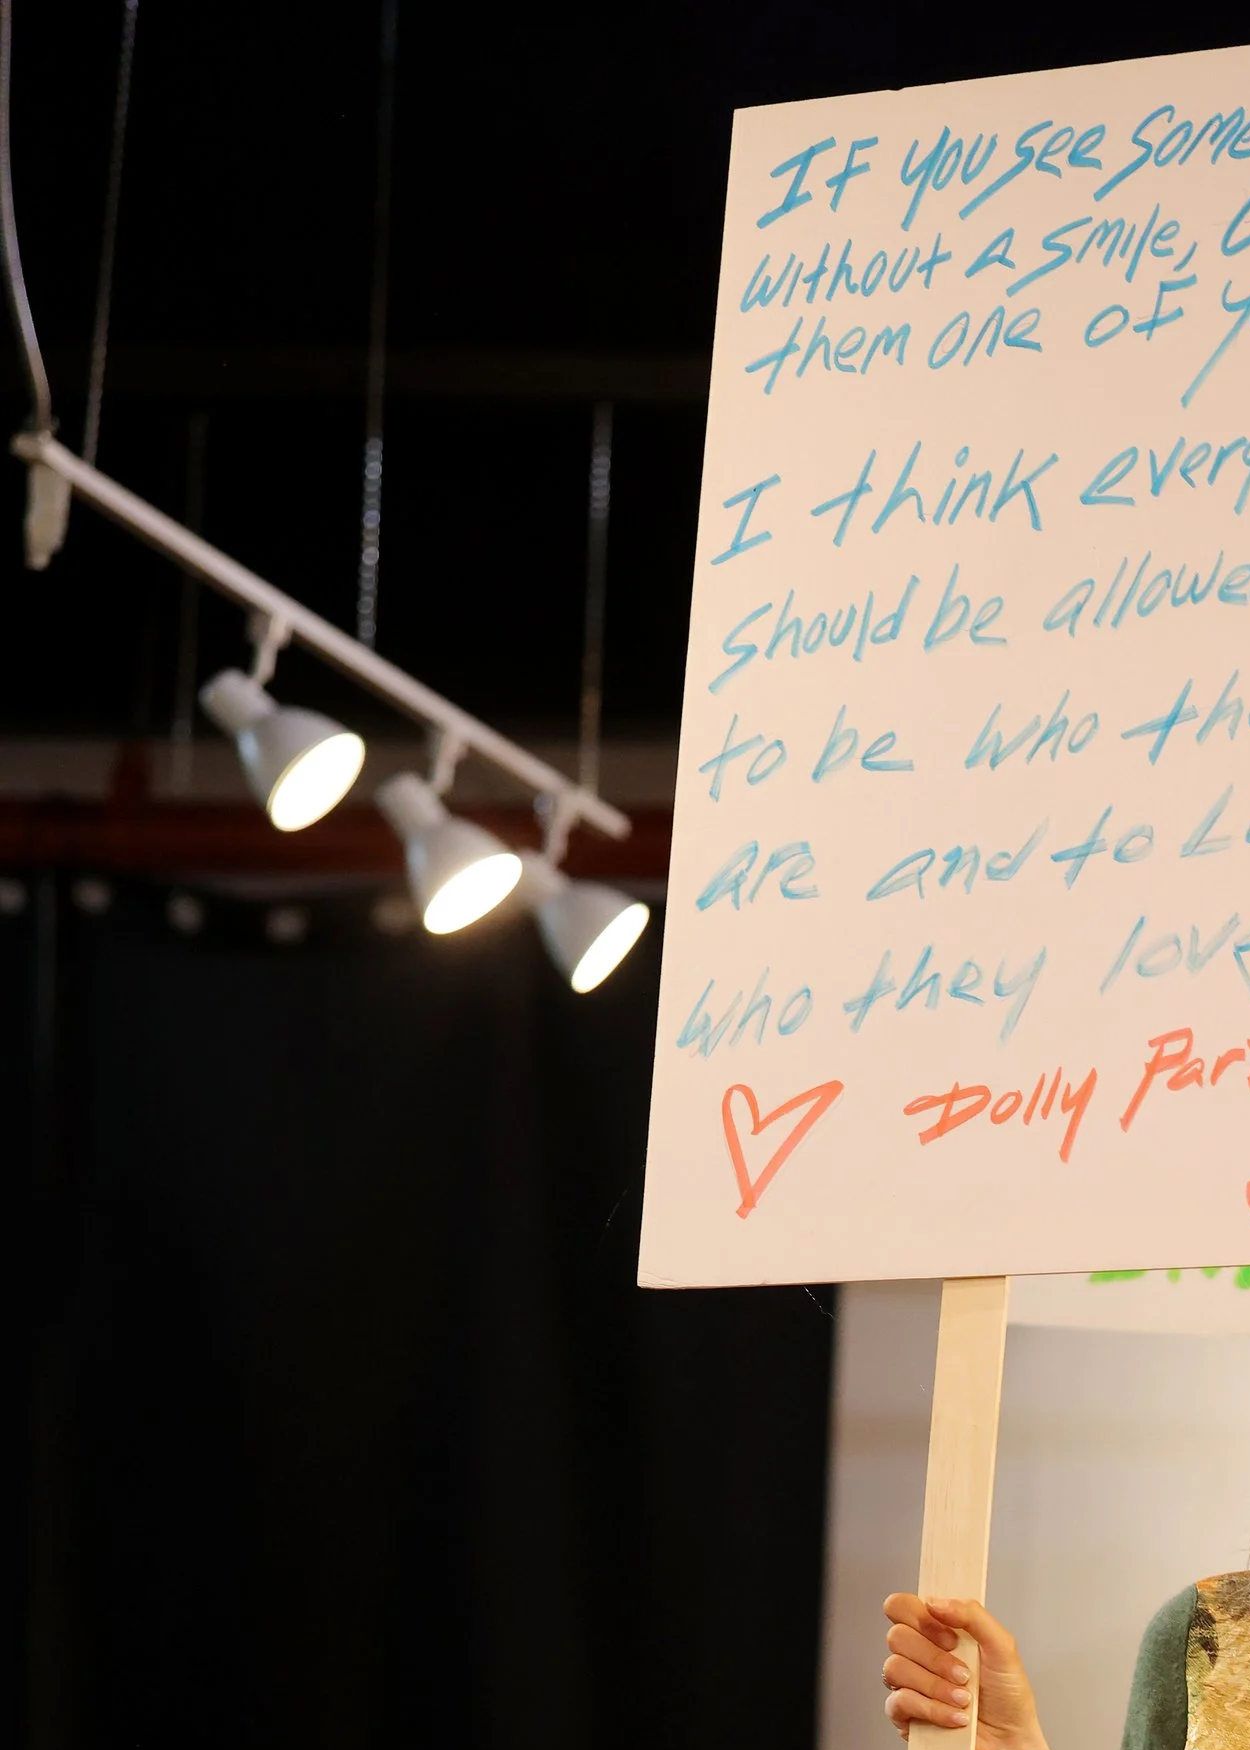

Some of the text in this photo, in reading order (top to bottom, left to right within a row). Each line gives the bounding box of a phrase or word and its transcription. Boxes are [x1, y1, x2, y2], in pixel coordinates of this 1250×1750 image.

[900, 124, 998, 232] you
[744, 315, 912, 395] them
[927, 304, 1044, 370] one
[710, 473, 783, 567] I
[922, 562, 1009, 655] be
[698, 711, 788, 804] to
[811, 702, 915, 784] be
[964, 688, 1100, 771] who
[864, 814, 1049, 902] and
[1050, 804, 1155, 890] to
[673, 964, 814, 1061] who
[842, 943, 1048, 1045] they
[902, 1066, 1098, 1164] Dolly
